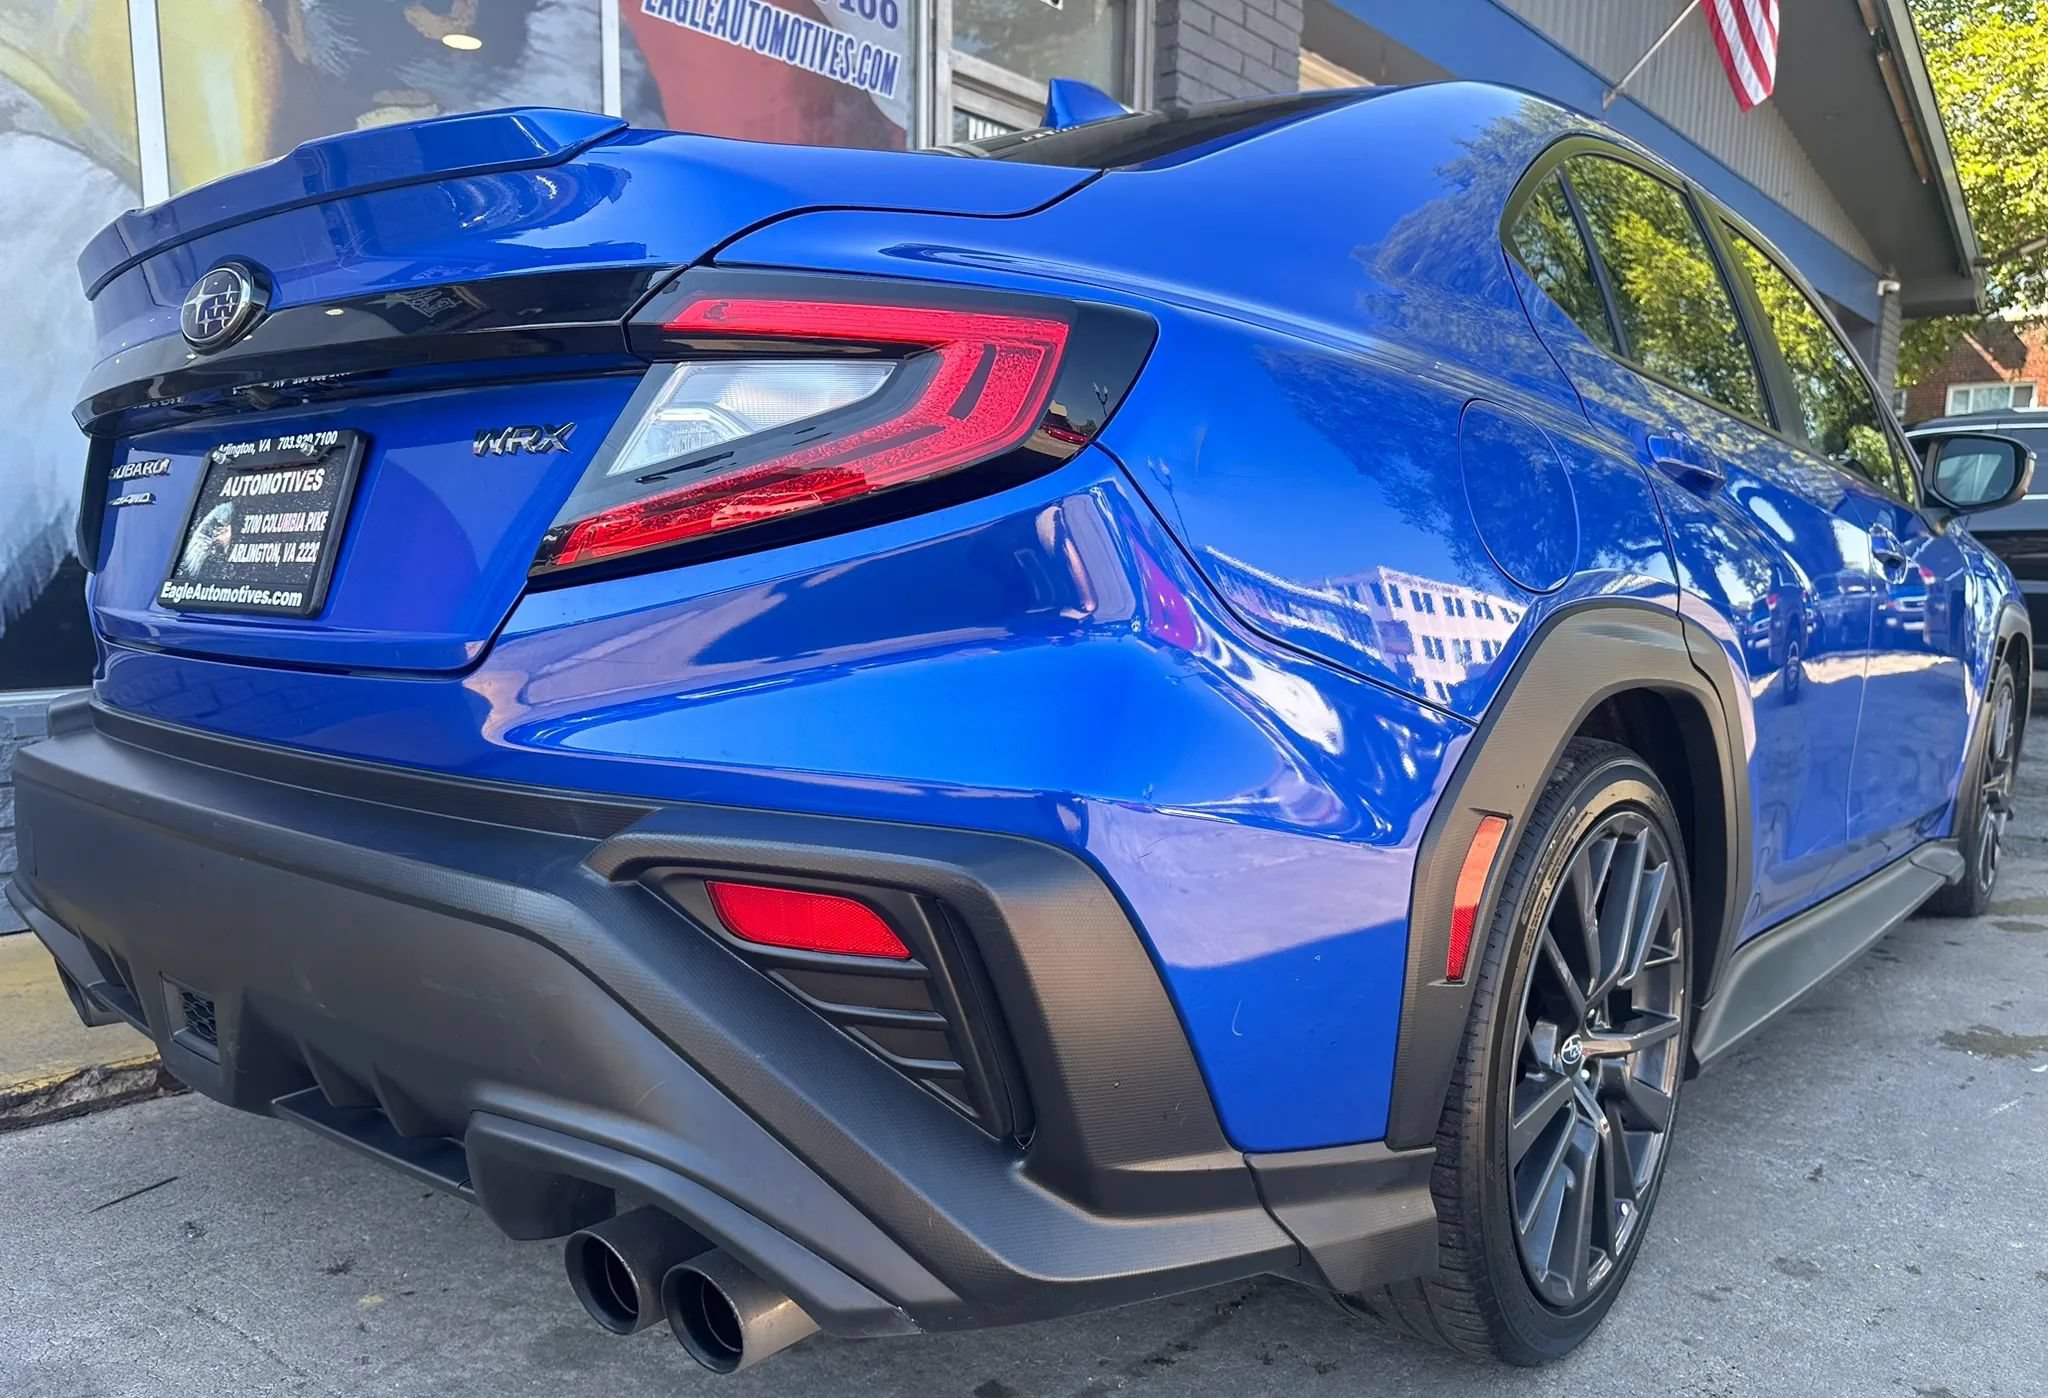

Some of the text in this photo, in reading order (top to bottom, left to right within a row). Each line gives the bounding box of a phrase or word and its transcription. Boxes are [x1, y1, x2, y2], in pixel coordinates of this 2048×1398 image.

[258, 438, 272, 452] VA
[277, 431, 338, 449] 703.9207100
[473, 422, 576, 458] WRX
[108, 458, 170, 480] SUBARU
[219, 468, 326, 497] AUTOMOTIVES
[241, 510, 329, 534] 3700 COLUMBIA PIKE
[228, 543, 281, 567] ARLINGTON,
[283, 542, 296, 562] VA
[160, 581, 303, 607] EagleAutomotives.com
